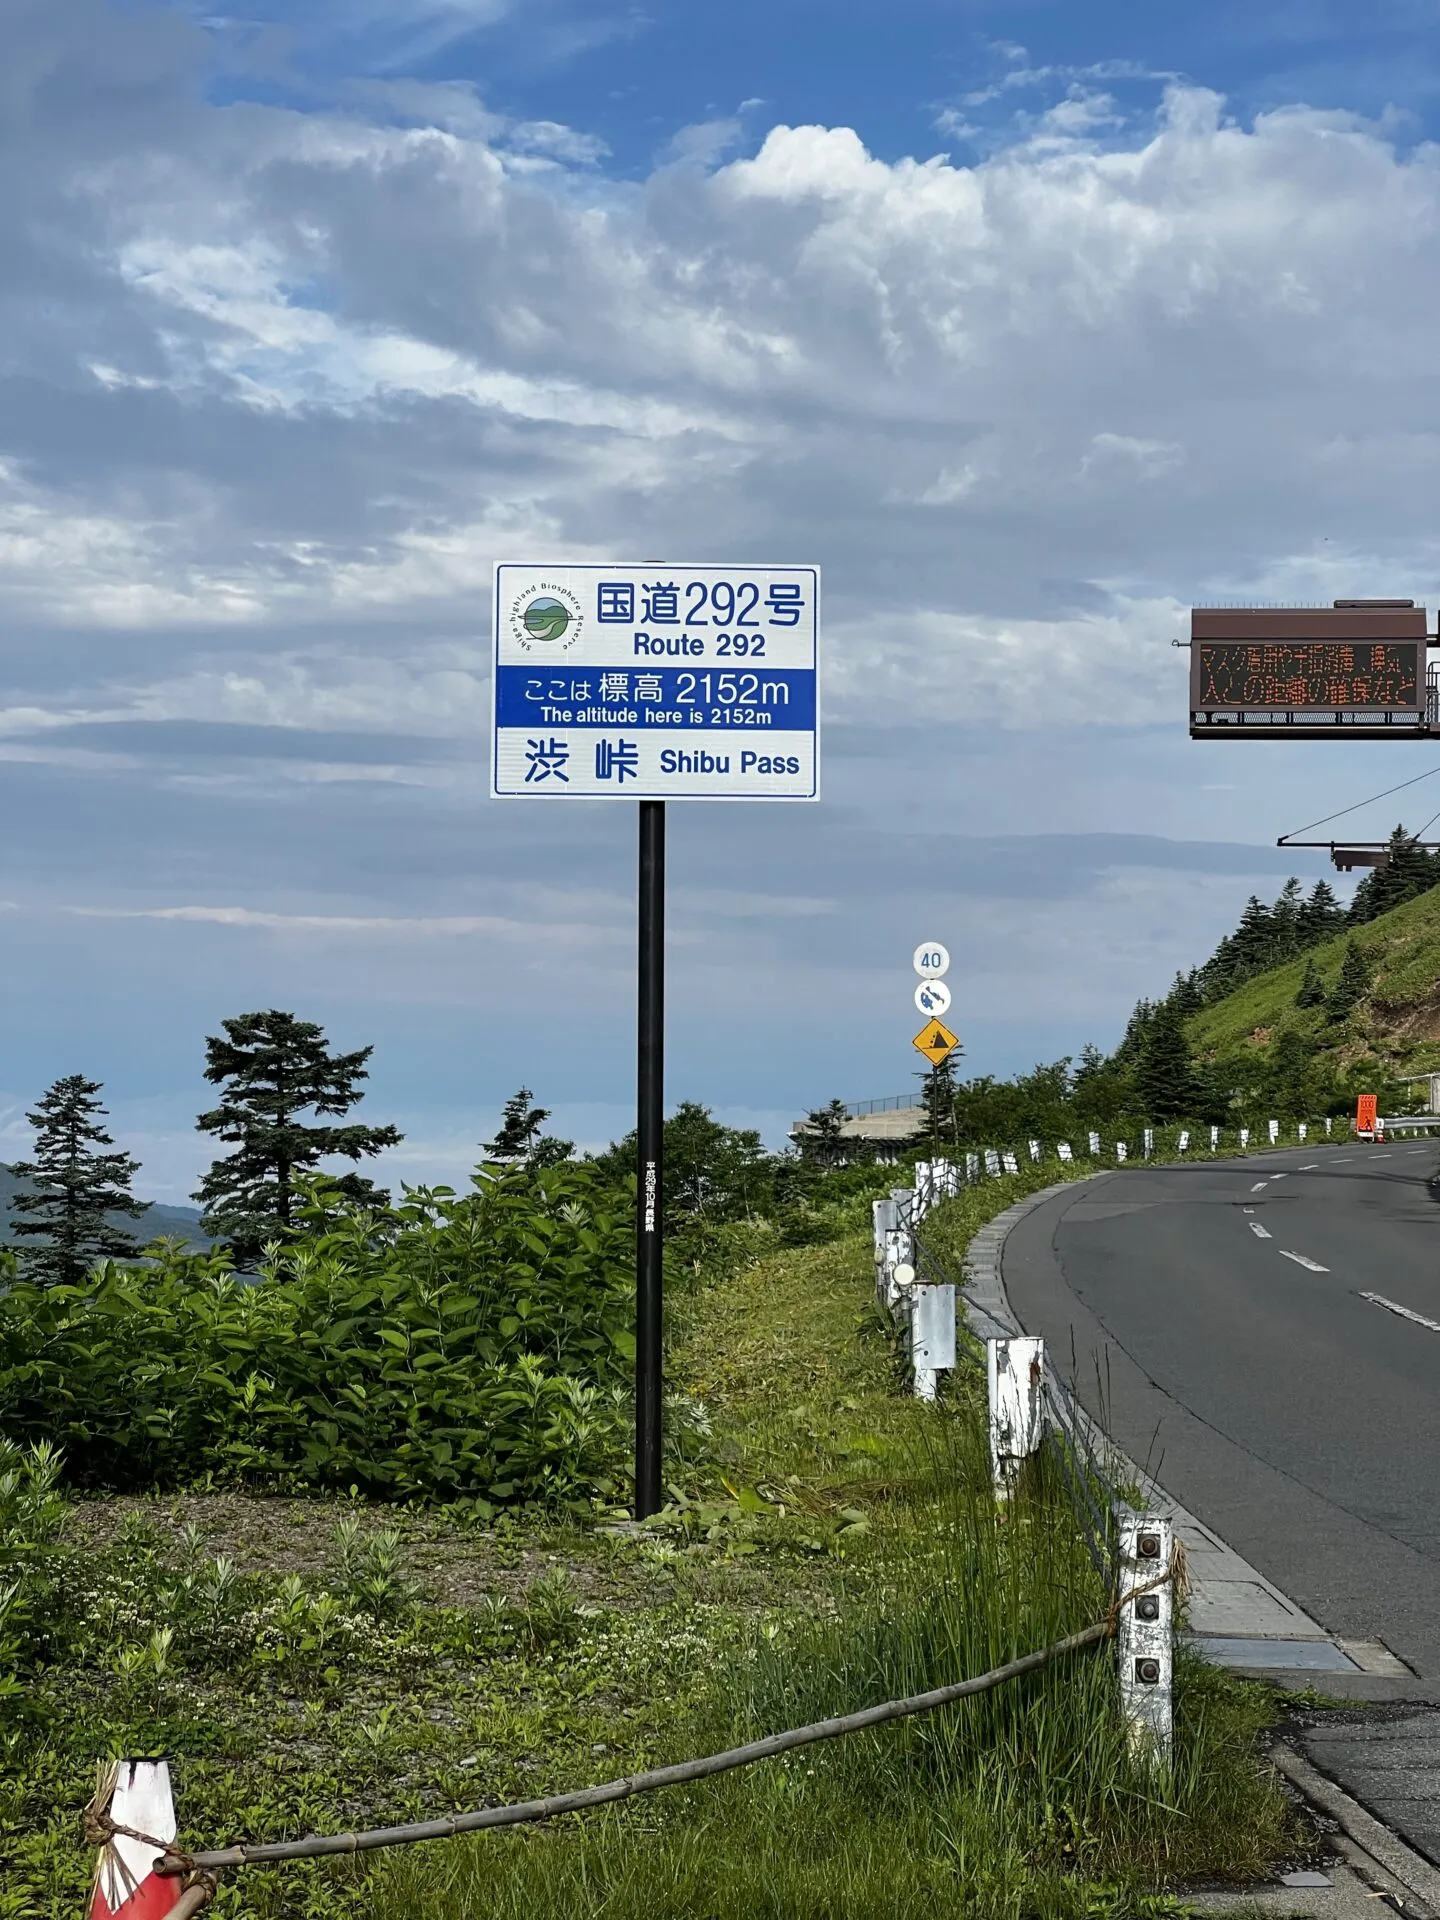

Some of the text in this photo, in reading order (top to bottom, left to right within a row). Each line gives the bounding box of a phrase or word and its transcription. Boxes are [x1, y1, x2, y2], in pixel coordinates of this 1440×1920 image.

[541, 583, 581, 611] Biosphere
[562, 615, 584, 650] Reserve
[597, 581, 805, 627] 国道292号
[633, 633, 766, 657] Route 292
[676, 673, 790, 705] 2152m
[540, 706, 772, 725] The altitude here is 2152m
[660, 749, 800, 775] Shibu Pass
[921, 953, 941, 968] 40
